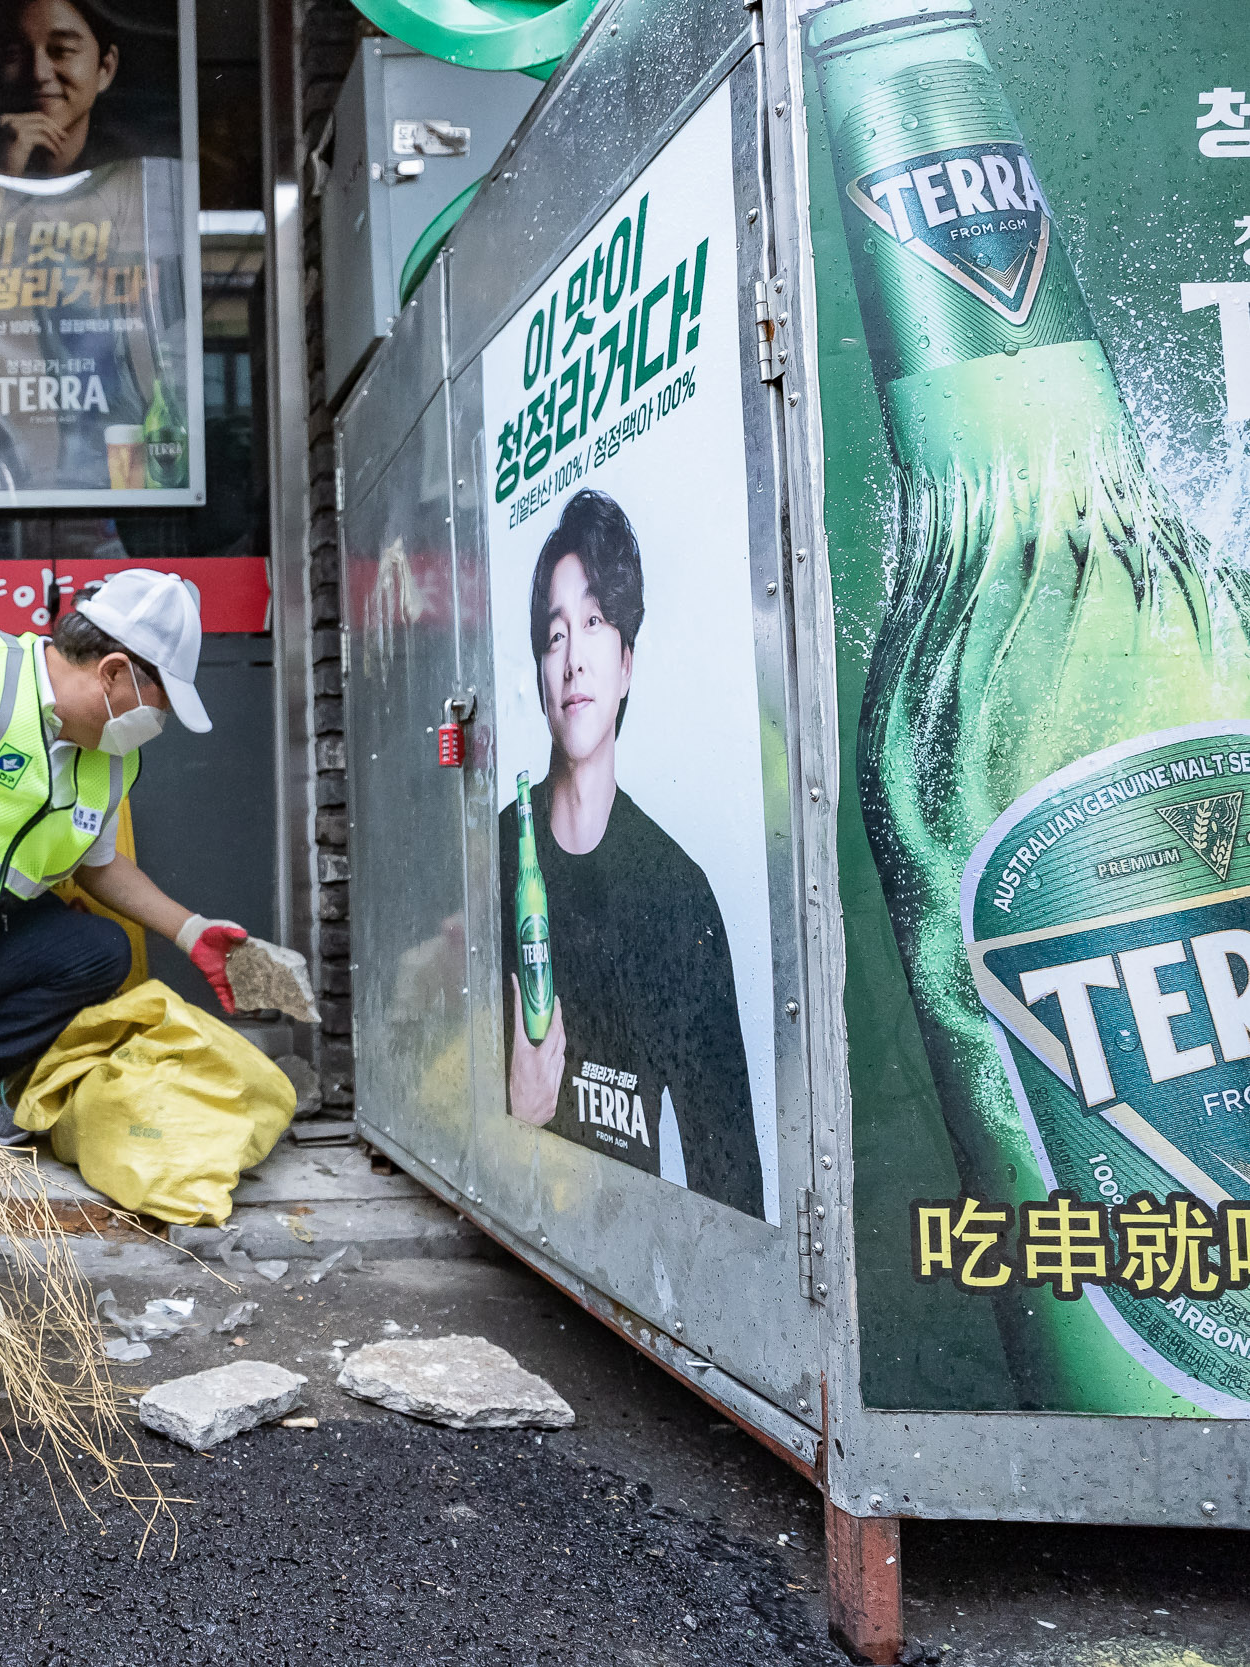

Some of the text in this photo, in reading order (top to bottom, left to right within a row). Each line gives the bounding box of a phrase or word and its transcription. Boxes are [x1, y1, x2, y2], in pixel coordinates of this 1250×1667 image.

[870, 153, 1052, 245] TERRA
[950, 217, 1028, 242] FROM AGM
[29, 220, 113, 264] 맛이
[523, 191, 650, 391] 이 맛이
[495, 236, 710, 505] 청정라거다!
[509, 478, 553, 531] 리얼탄산
[554, 456, 584, 493] 100%
[593, 396, 654, 469] 청정맥아
[656, 366, 697, 422] 100%
[992, 804, 1088, 914] AUSTRALIAN
[1082, 764, 1171, 817] GENUINE
[1169, 754, 1226, 784] MALT
[1097, 848, 1182, 878] PREMIUM
[521, 942, 550, 966] TERRA
[581, 1060, 639, 1092] 청정라거-테라
[572, 1075, 650, 1148] TERRA
[595, 1130, 629, 1150] FROM AGM
[918, 1197, 1250, 1294] 吃串就
[1156, 1293, 1250, 1359] ARBON
